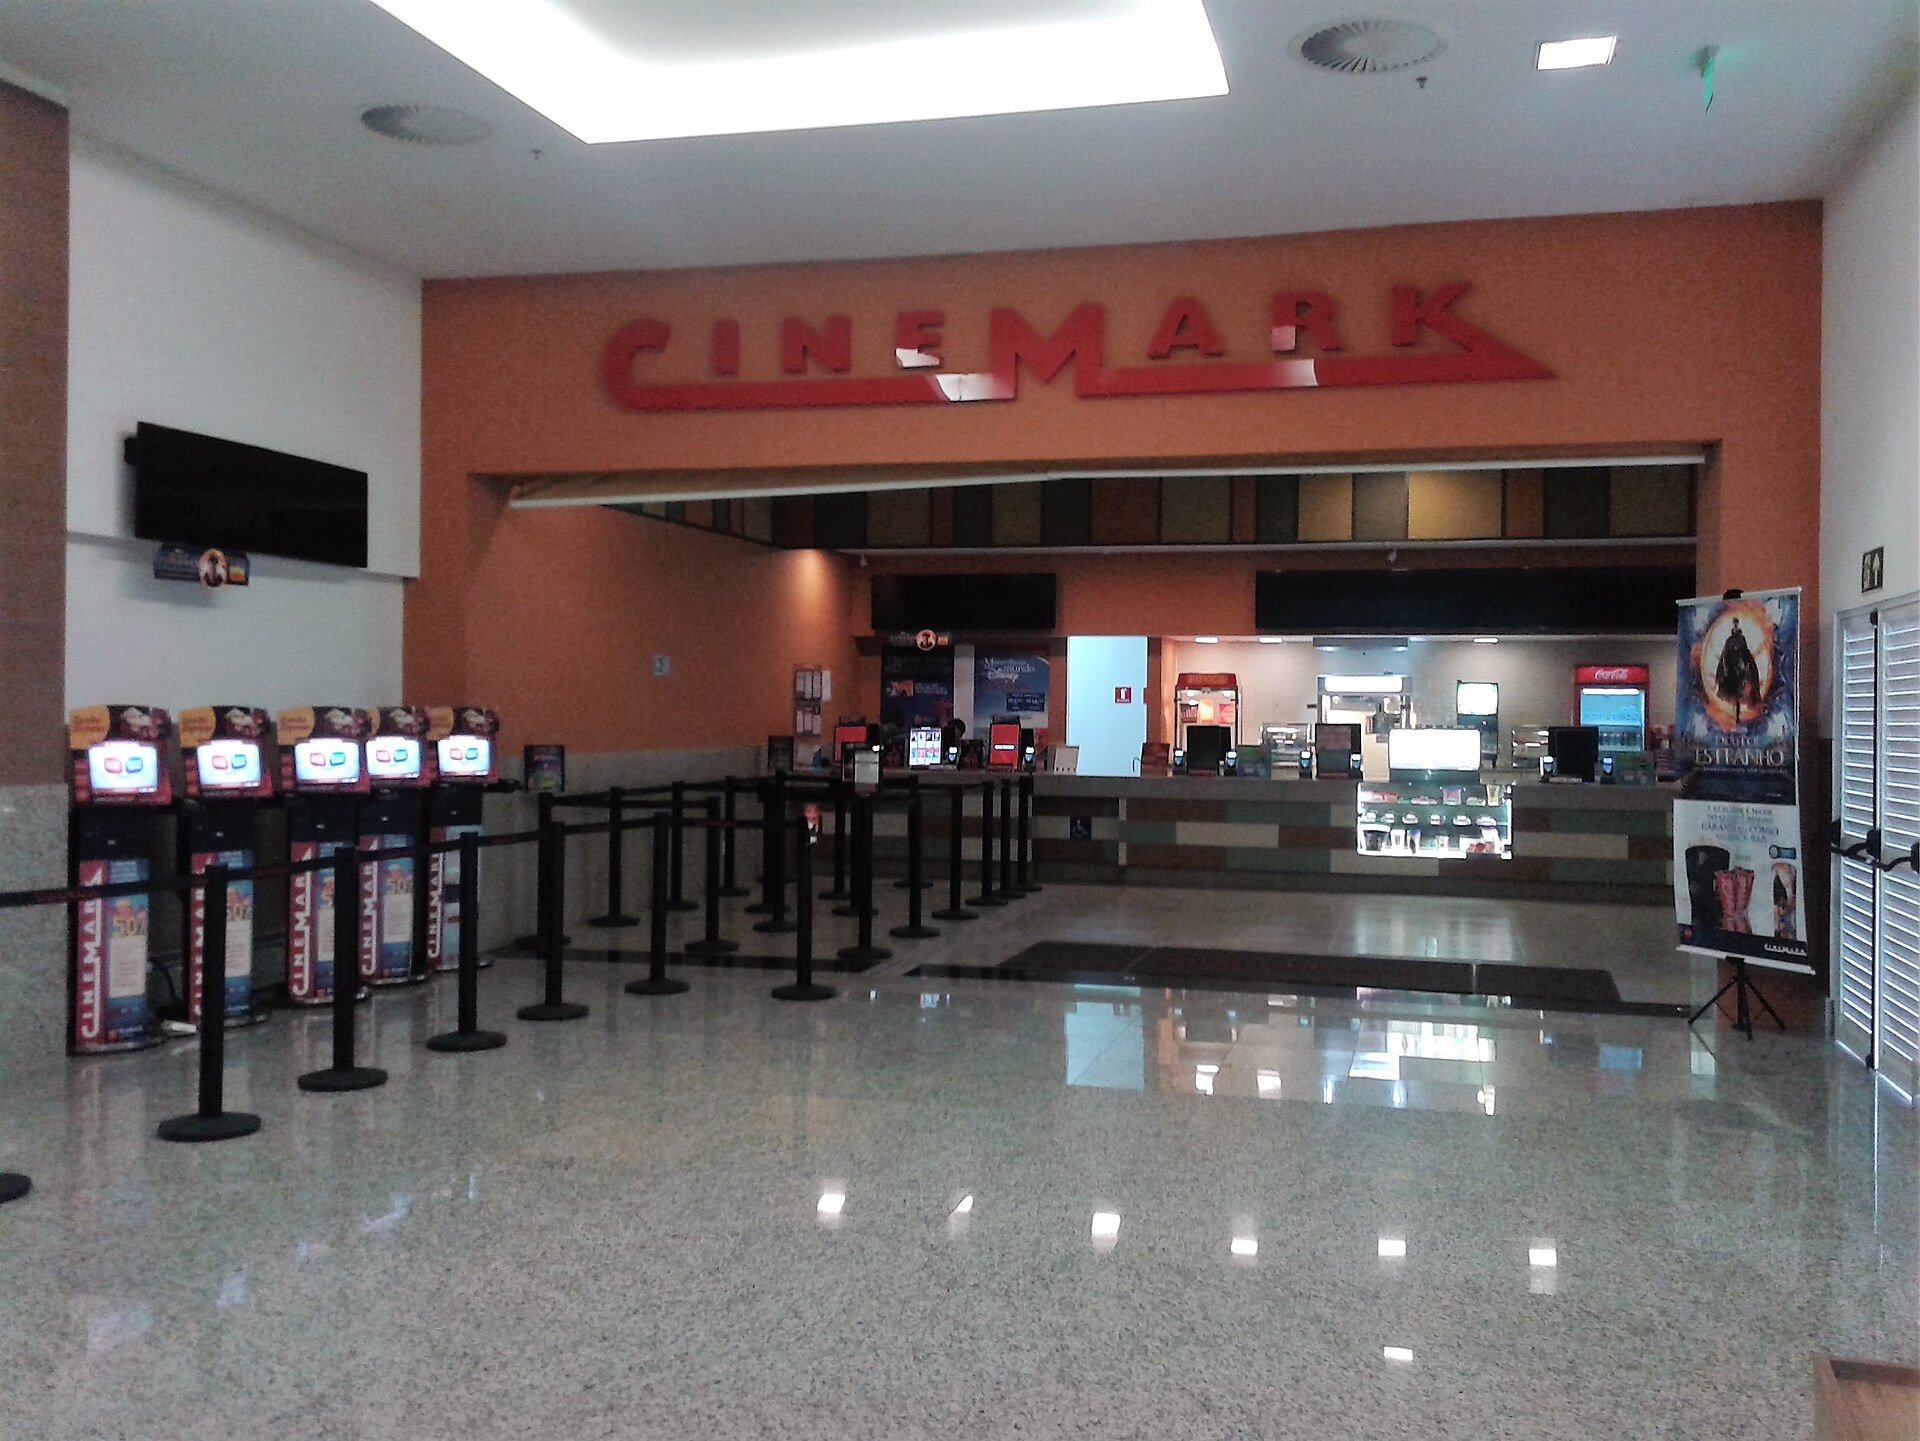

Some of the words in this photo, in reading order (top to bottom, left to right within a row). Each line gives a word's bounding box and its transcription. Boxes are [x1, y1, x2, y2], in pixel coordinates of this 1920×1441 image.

[604, 280, 1556, 413] CINEMARK
[1695, 748, 1784, 766] ESTRANHO
[292, 848, 311, 996] CINEMAR
[362, 839, 378, 975] CINEMAR
[428, 853, 443, 958] CINEMAR
